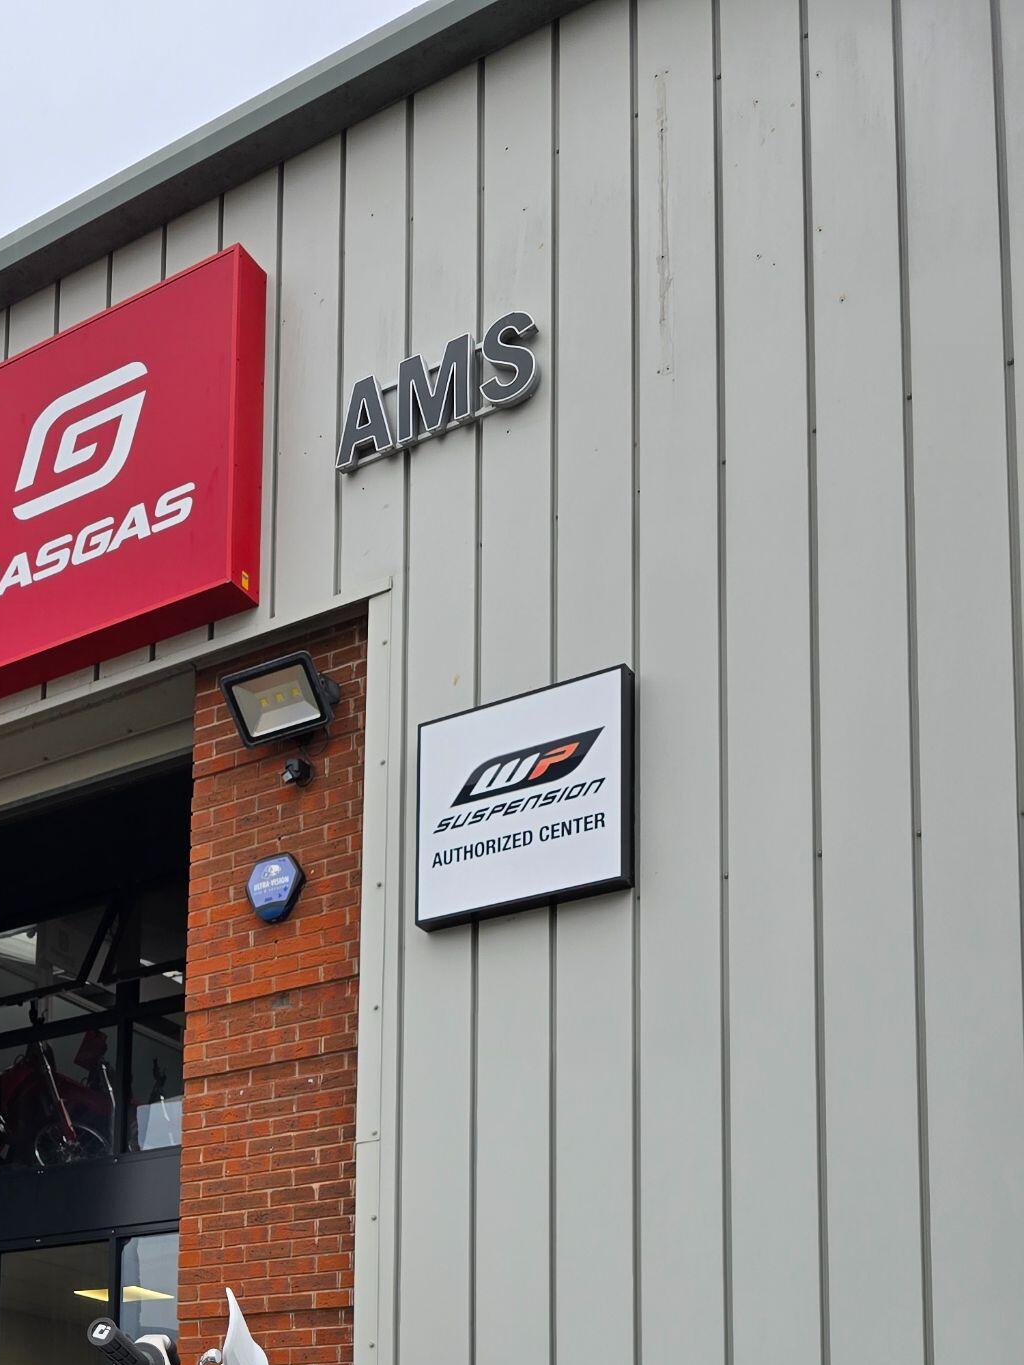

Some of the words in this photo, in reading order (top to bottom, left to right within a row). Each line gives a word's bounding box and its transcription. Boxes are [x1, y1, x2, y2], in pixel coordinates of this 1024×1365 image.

[336, 311, 536, 469] AMS
[433, 777, 606, 834] SUSPENSION
[432, 830, 533, 869] AUTHORIZED
[539, 812, 606, 842] CENTER
